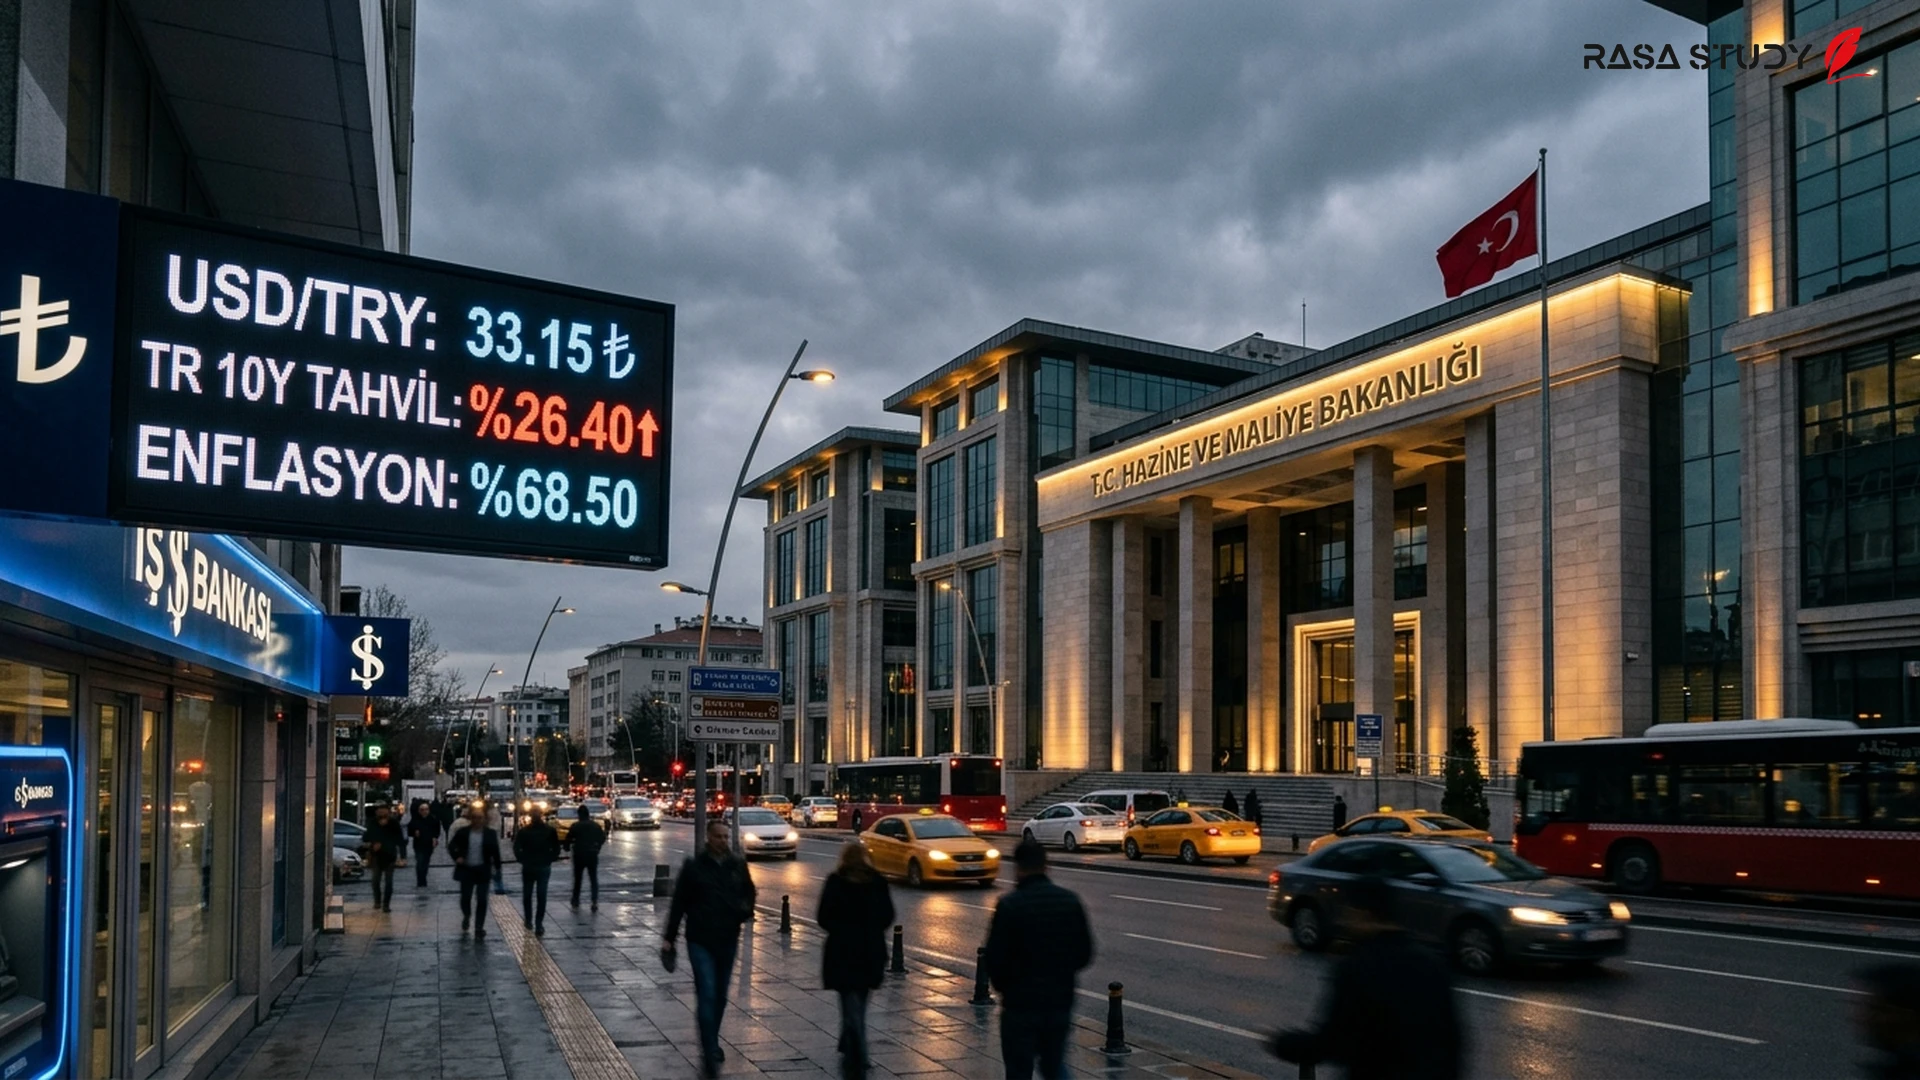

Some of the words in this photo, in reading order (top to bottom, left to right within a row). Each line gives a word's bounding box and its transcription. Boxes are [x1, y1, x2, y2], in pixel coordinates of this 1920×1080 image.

[167, 253, 437, 351] USD/TRY:
[141, 339, 203, 394] TR
[217, 352, 296, 405] 10Y
[306, 363, 462, 429] TAHVİL:
[470, 384, 635, 454] %26.40
[1091, 472, 1120, 498] T.C.
[1123, 444, 1193, 488] HAZİNE
[1195, 432, 1223, 464] VE
[1226, 402, 1314, 456] MALİYE
[1318, 341, 1482, 427] BAKANLIĞI
[136, 424, 459, 509] ENFLASYON:
[470, 461, 638, 529] %68.50
[192, 548, 273, 644] BANKASI
